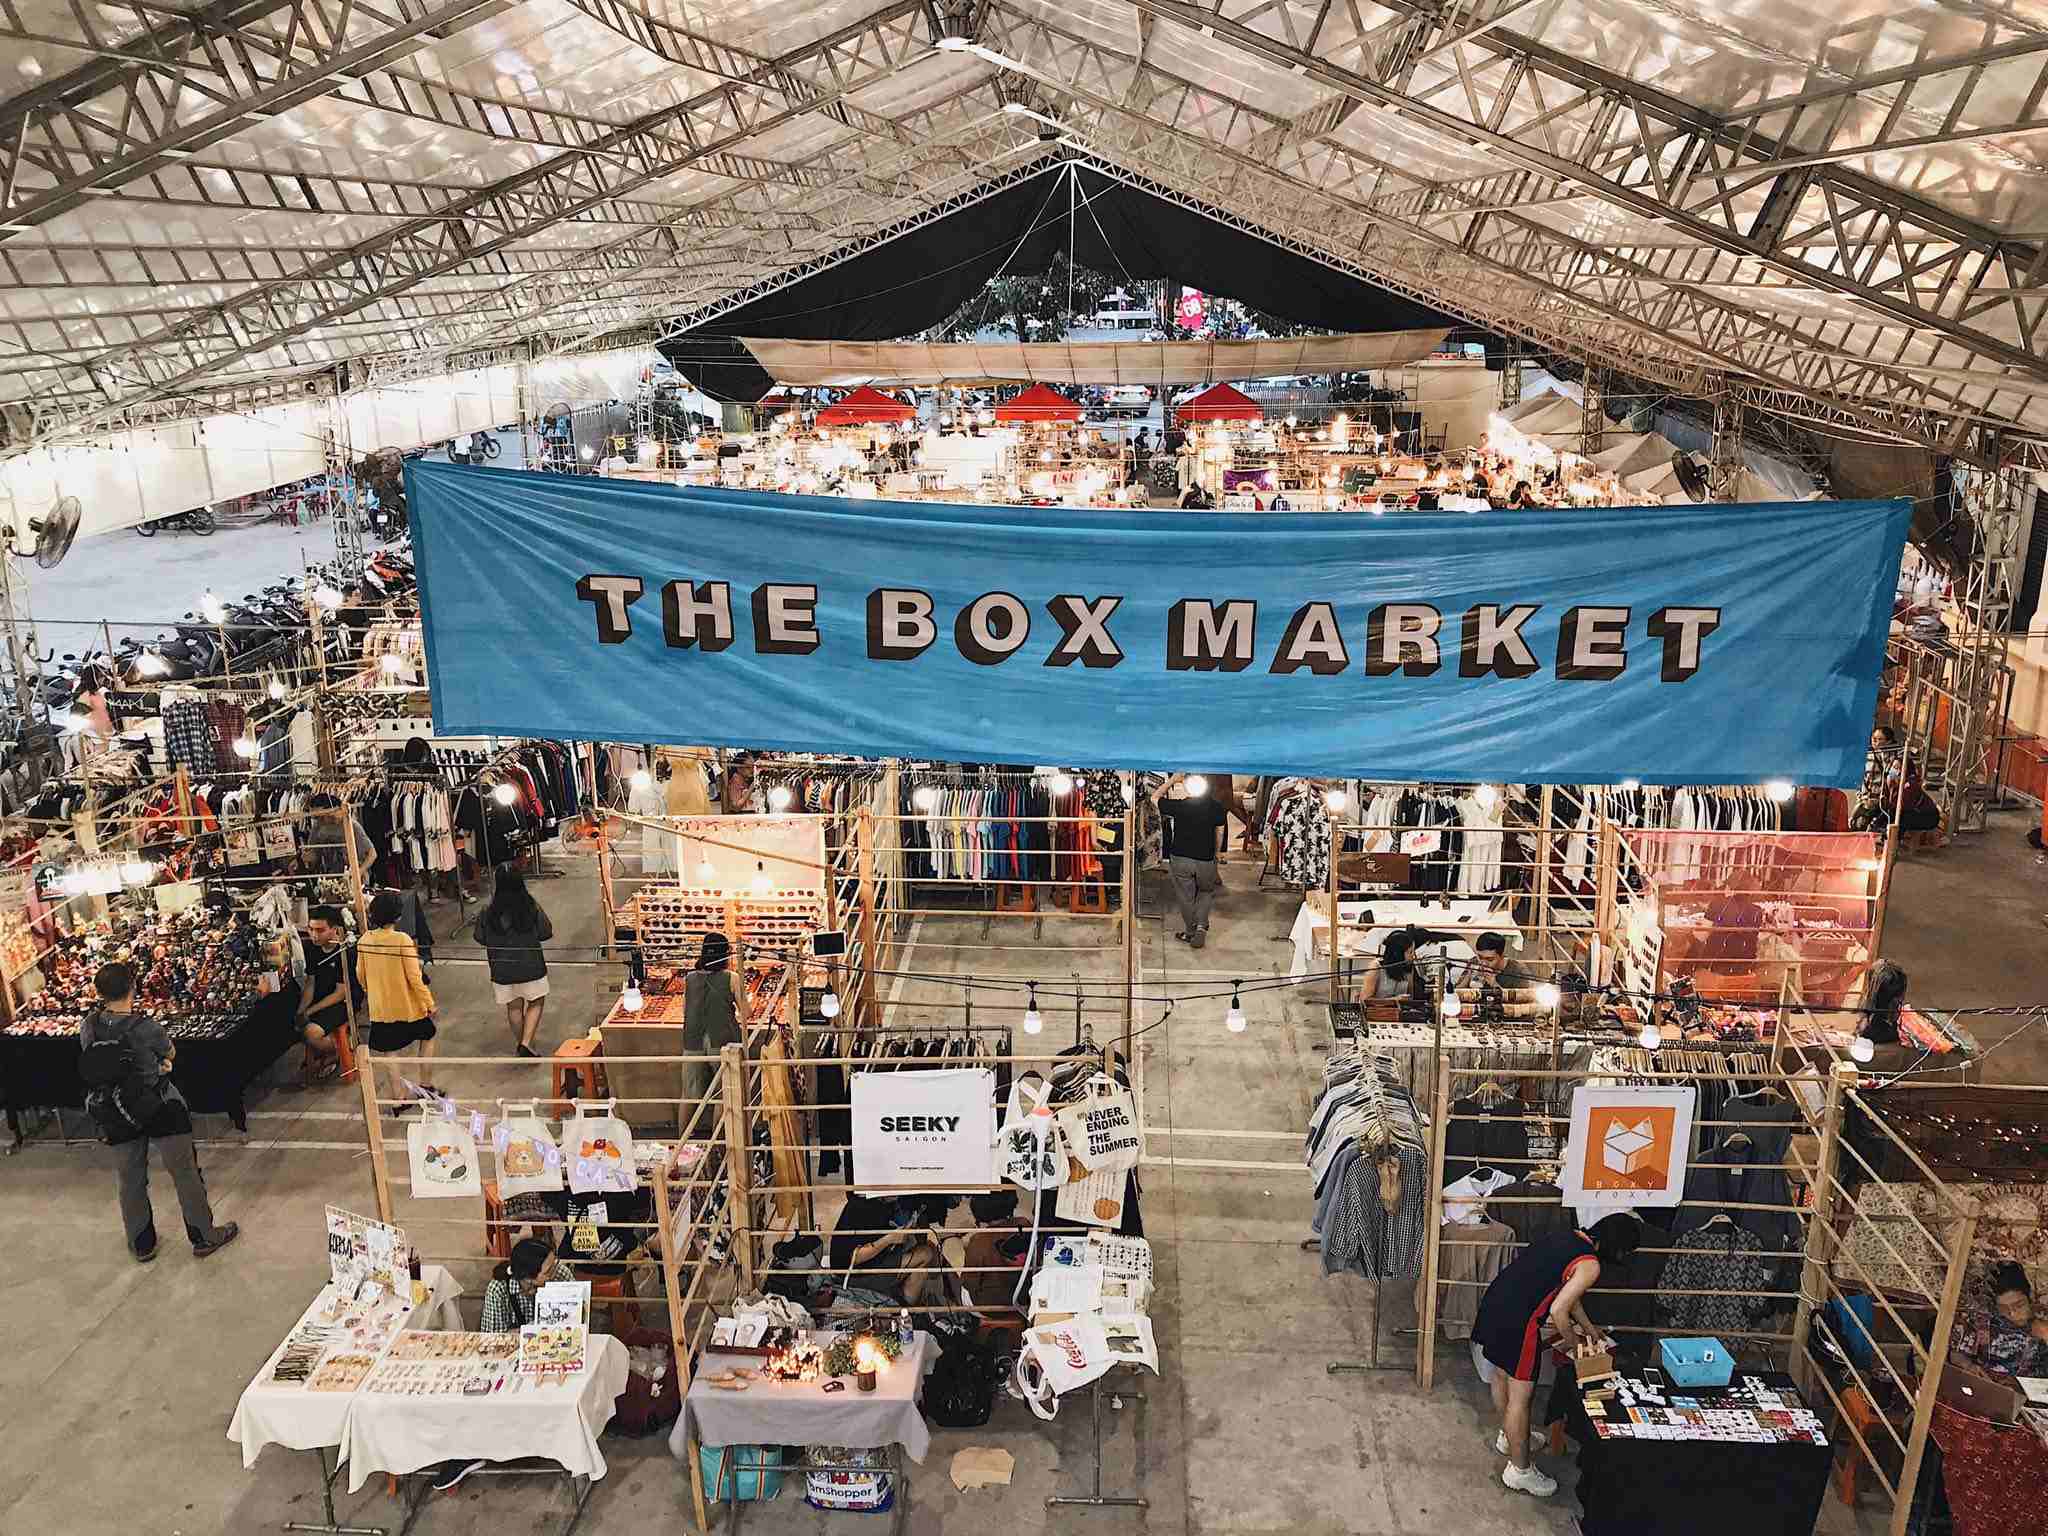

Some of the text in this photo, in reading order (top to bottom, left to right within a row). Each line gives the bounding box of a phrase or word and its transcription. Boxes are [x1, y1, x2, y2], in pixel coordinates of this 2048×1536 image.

[576, 574, 1721, 682] THE BOX MARKET
[1085, 1106, 1122, 1122] NEVER
[880, 1116, 960, 1133] SEEKY
[1086, 1116, 1130, 1132] ENDING
[1088, 1132, 1111, 1145] THE
[1089, 1137, 1139, 1156] SUMMER
[1595, 1191, 1654, 1199] FOXY
